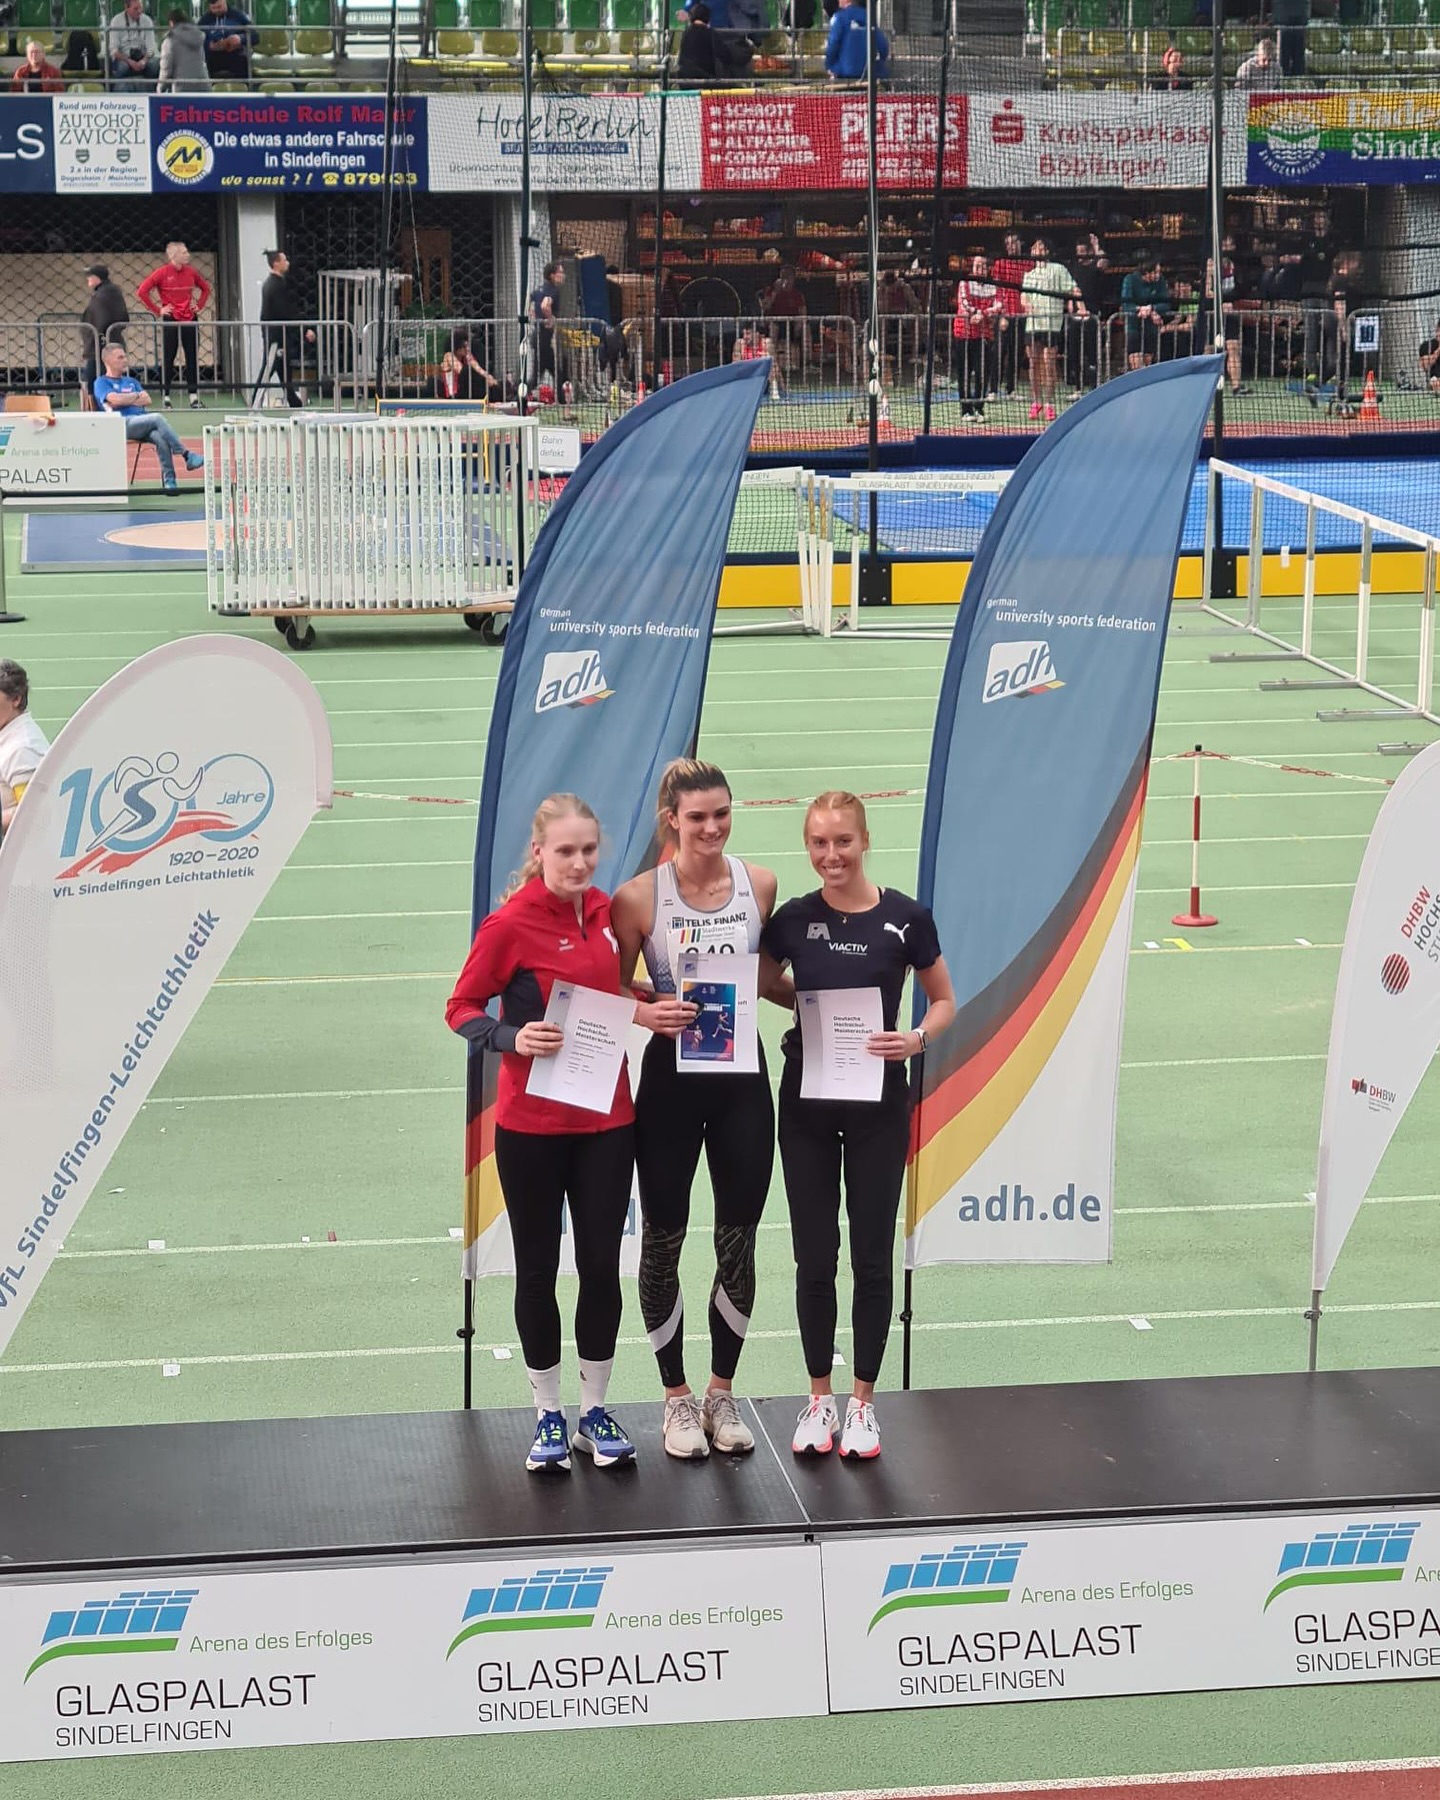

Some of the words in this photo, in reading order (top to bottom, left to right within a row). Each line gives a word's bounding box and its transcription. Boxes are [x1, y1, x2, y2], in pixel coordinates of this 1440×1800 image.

[59, 102, 79, 110] Rund
[160, 105, 289, 123] Fahrschule
[297, 105, 343, 123] Rolf
[351, 106, 416, 123] Maer
[725, 103, 796, 117] SCHROTT
[60, 113, 144, 128] AUTOHOF
[59, 129, 145, 145] ZWICKL
[214, 132, 237, 147] Die
[240, 133, 281, 147] etwas
[286, 132, 333, 147] andere
[110, 166, 138, 174] Region
[265, 152, 278, 168] in
[221, 174, 242, 185] wo
[246, 173, 285, 185] sonst
[725, 166, 780, 180] DIENST
[11, 448, 39, 456] Arena
[42, 447, 58, 456] des
[61, 446, 99, 457] Erfolges
[540, 607, 571, 618] german
[986, 598, 1018, 609] german
[550, 618, 606, 637] university
[609, 623, 642, 637] sports
[645, 621, 700, 638] federation
[996, 609, 1055, 627] university
[1057, 614, 1094, 627] sports
[1097, 614, 1156, 632] federation
[539, 654, 602, 708] adh
[986, 644, 1051, 699] adh
[216, 791, 266, 805] Jahre
[53, 887, 75, 898] VfL
[78, 877, 161, 895] Sindelfingen
[165, 867, 255, 885] Leichtathletik
[685, 918, 711, 927] TELIS
[714, 912, 747, 925] FINANZ
[1401, 885, 1431, 939] DHBW
[829, 942, 868, 952] VIACTIV
[575, 1032, 616, 1046] Meisterschaft
[17, 907, 221, 1258] Sindelfingen-Leichtathletik
[1370, 1085, 1396, 1103] DHBW
[958, 1183, 1102, 1222] adh.de
[1020, 1586, 1076, 1604] Arena
[1082, 1584, 1114, 1600] des
[1119, 1581, 1193, 1601] Erfolges
[604, 1612, 663, 1630] Arena
[668, 1609, 702, 1627] des
[708, 1606, 783, 1627] Erfolges
[1294, 1608, 1440, 1645] GLASPA
[189, 1635, 248, 1653] Arena
[255, 1632, 290, 1650] des
[295, 1629, 373, 1651] Erfolges
[898, 1624, 1142, 1667] GLASPALAST
[478, 1650, 729, 1693] GLASPALAST
[1296, 1647, 1440, 1676] SINDELFINGE
[900, 1668, 1065, 1696] SINDELFINGEN
[56, 1674, 316, 1718] GLASPALAST
[478, 1694, 649, 1723] SINDELFINGEN
[56, 1720, 232, 1748] SINDELFINGEN
